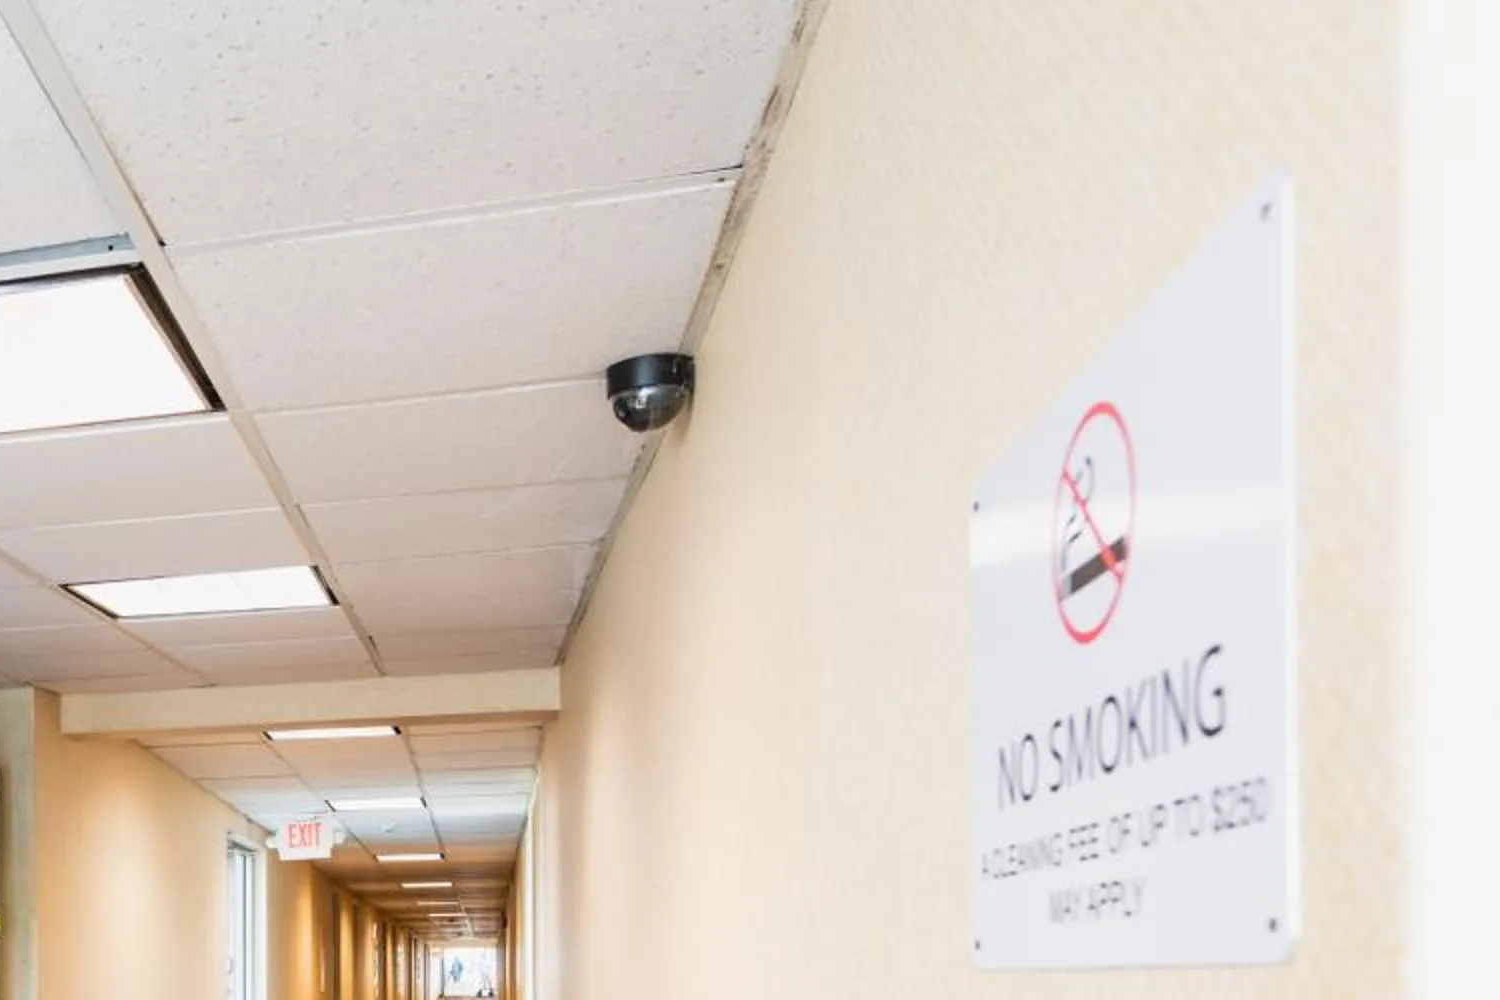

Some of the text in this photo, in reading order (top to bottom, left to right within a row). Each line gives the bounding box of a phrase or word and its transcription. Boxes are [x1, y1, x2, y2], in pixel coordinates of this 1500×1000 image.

[998, 644, 1227, 811] NO SMOKING
[287, 823, 323, 849] EXIT
[1069, 822, 1099, 864] FEE
[1106, 811, 1133, 855] OF
[1138, 803, 1169, 848] UP
[1172, 794, 1205, 841] TO
